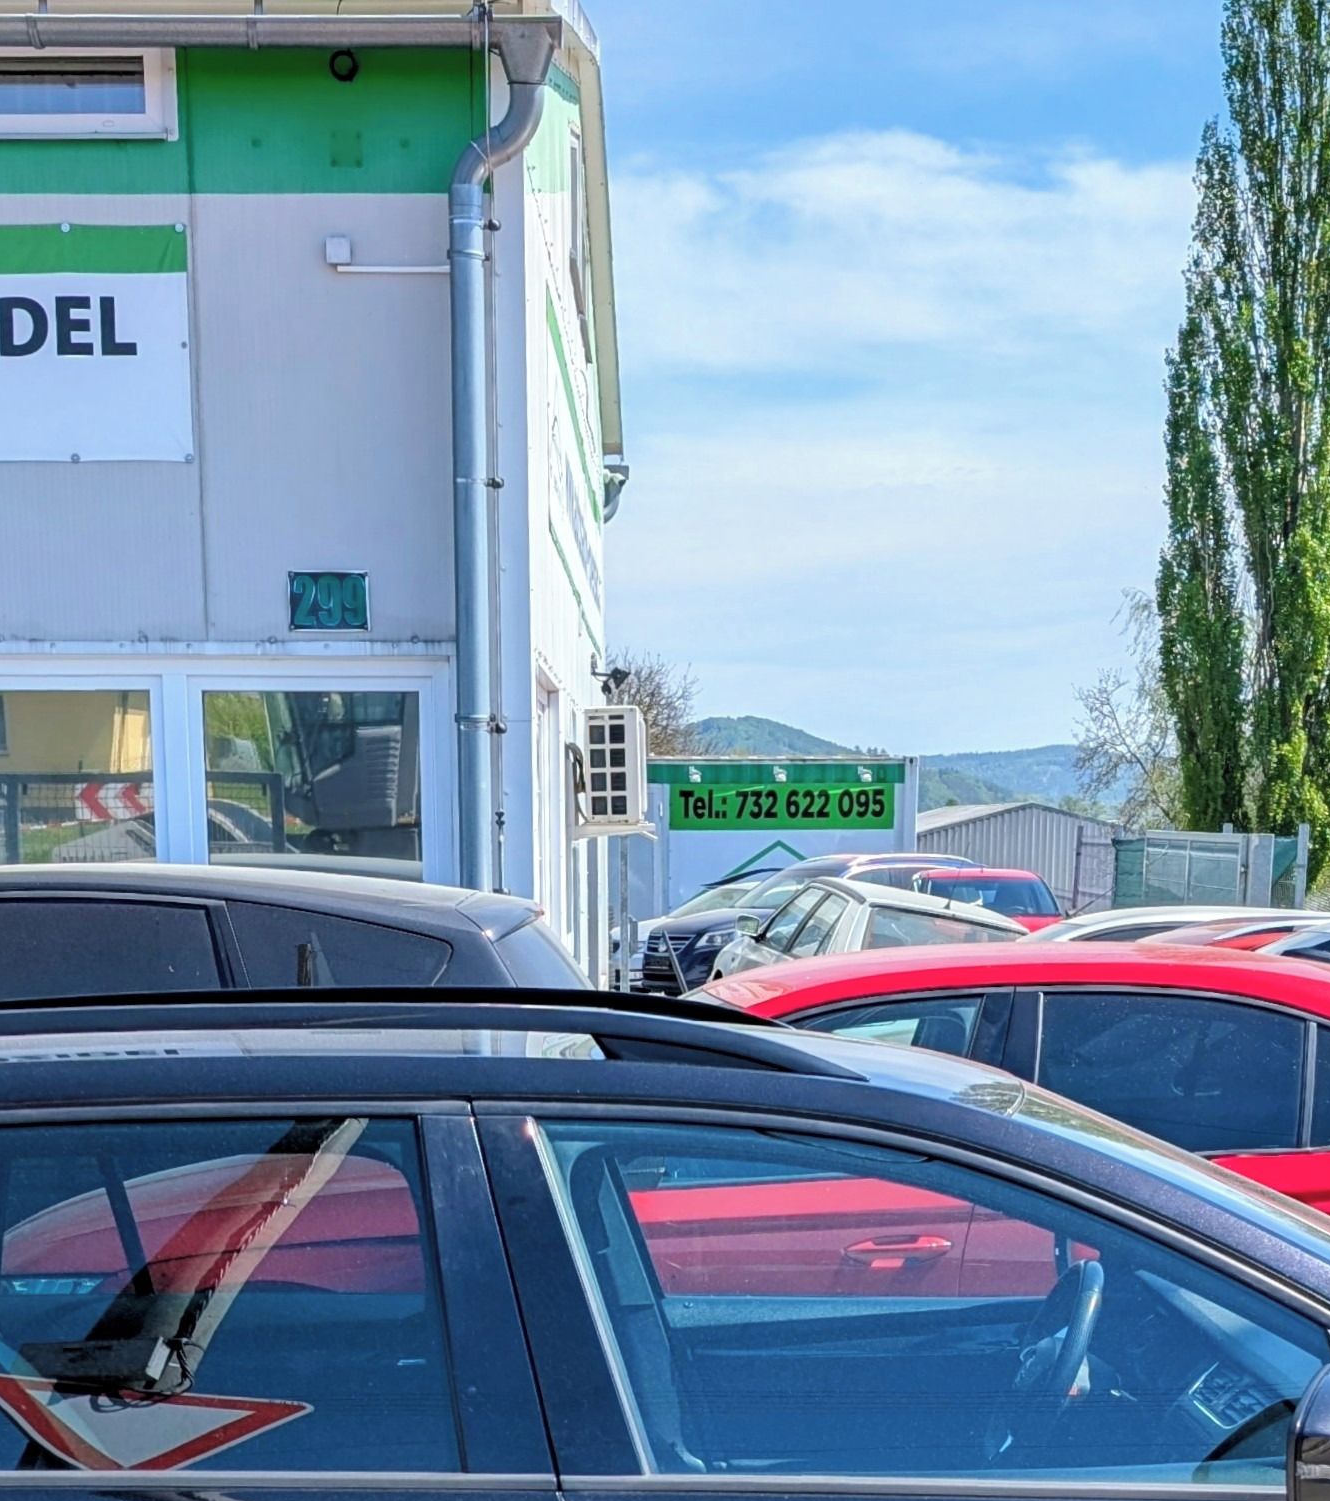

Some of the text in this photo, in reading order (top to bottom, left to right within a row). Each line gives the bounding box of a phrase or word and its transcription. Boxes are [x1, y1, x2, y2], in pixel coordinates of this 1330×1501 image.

[293, 574, 368, 628] 299
[679, 789, 885, 819] Tel.: 732 622 095
